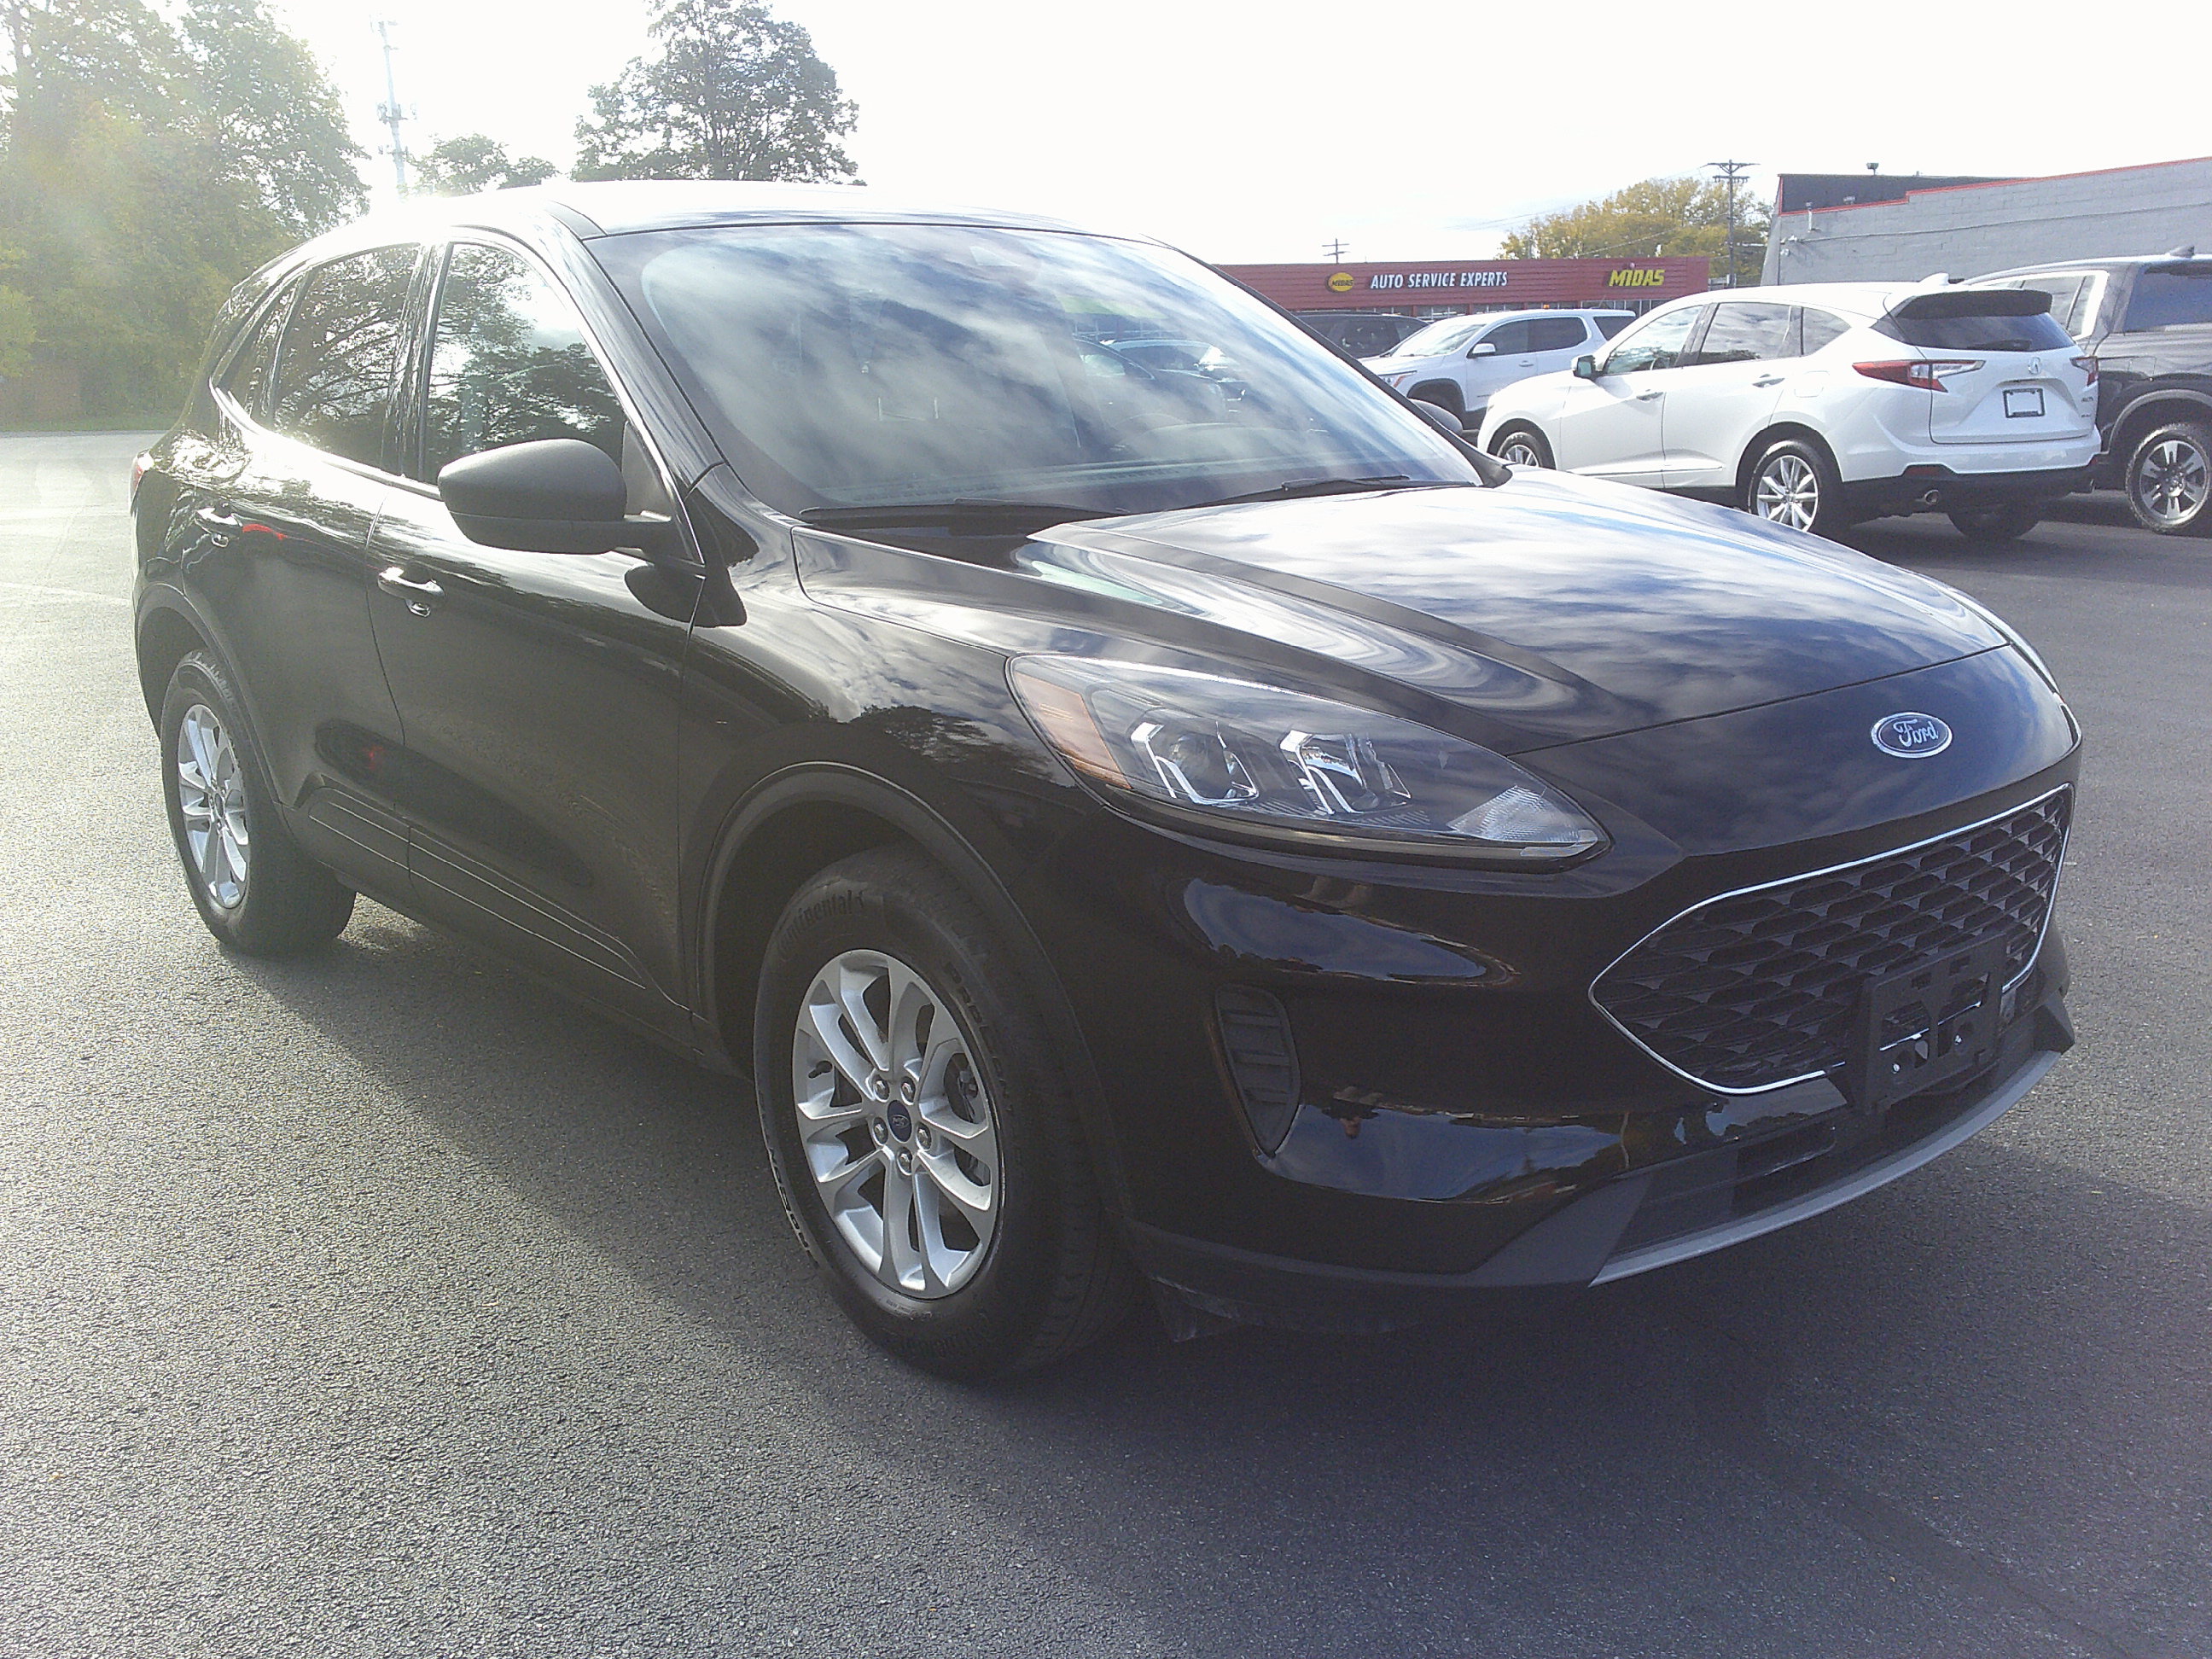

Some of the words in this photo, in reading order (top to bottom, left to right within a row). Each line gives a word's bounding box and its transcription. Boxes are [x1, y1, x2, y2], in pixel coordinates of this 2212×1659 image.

[1370, 274, 1404, 288] AUTO
[1408, 273, 1456, 288] SERVICE
[1460, 271, 1508, 287] EXPERTS
[1609, 269, 1666, 287] MIDAS
[1893, 719, 1939, 747] Ford
